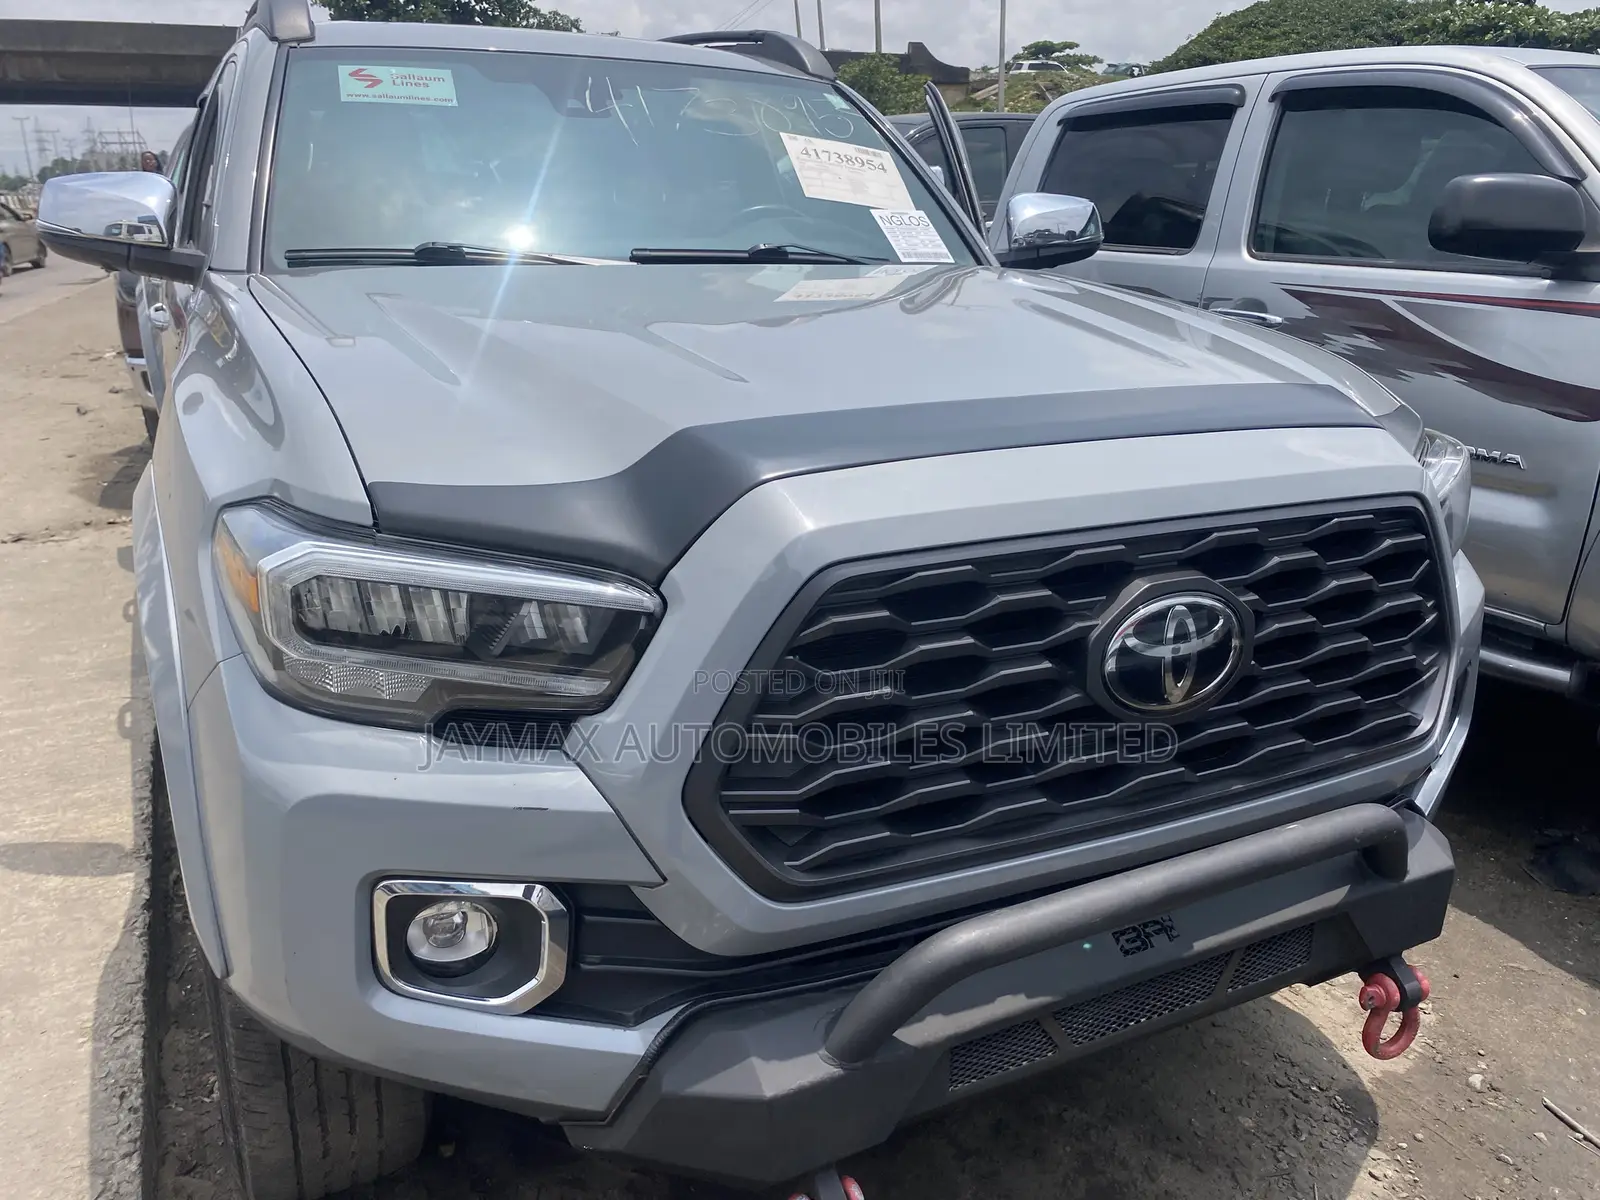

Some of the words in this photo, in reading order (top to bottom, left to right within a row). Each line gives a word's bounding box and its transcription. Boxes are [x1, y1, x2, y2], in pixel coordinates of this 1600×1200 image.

[390, 73, 445, 82] Sallaum
[392, 80, 430, 88] Lines
[346, 92, 454, 103] www.sallaumlines.com
[800, 146, 887, 174] 41738954
[879, 215, 930, 227] NGLOS
